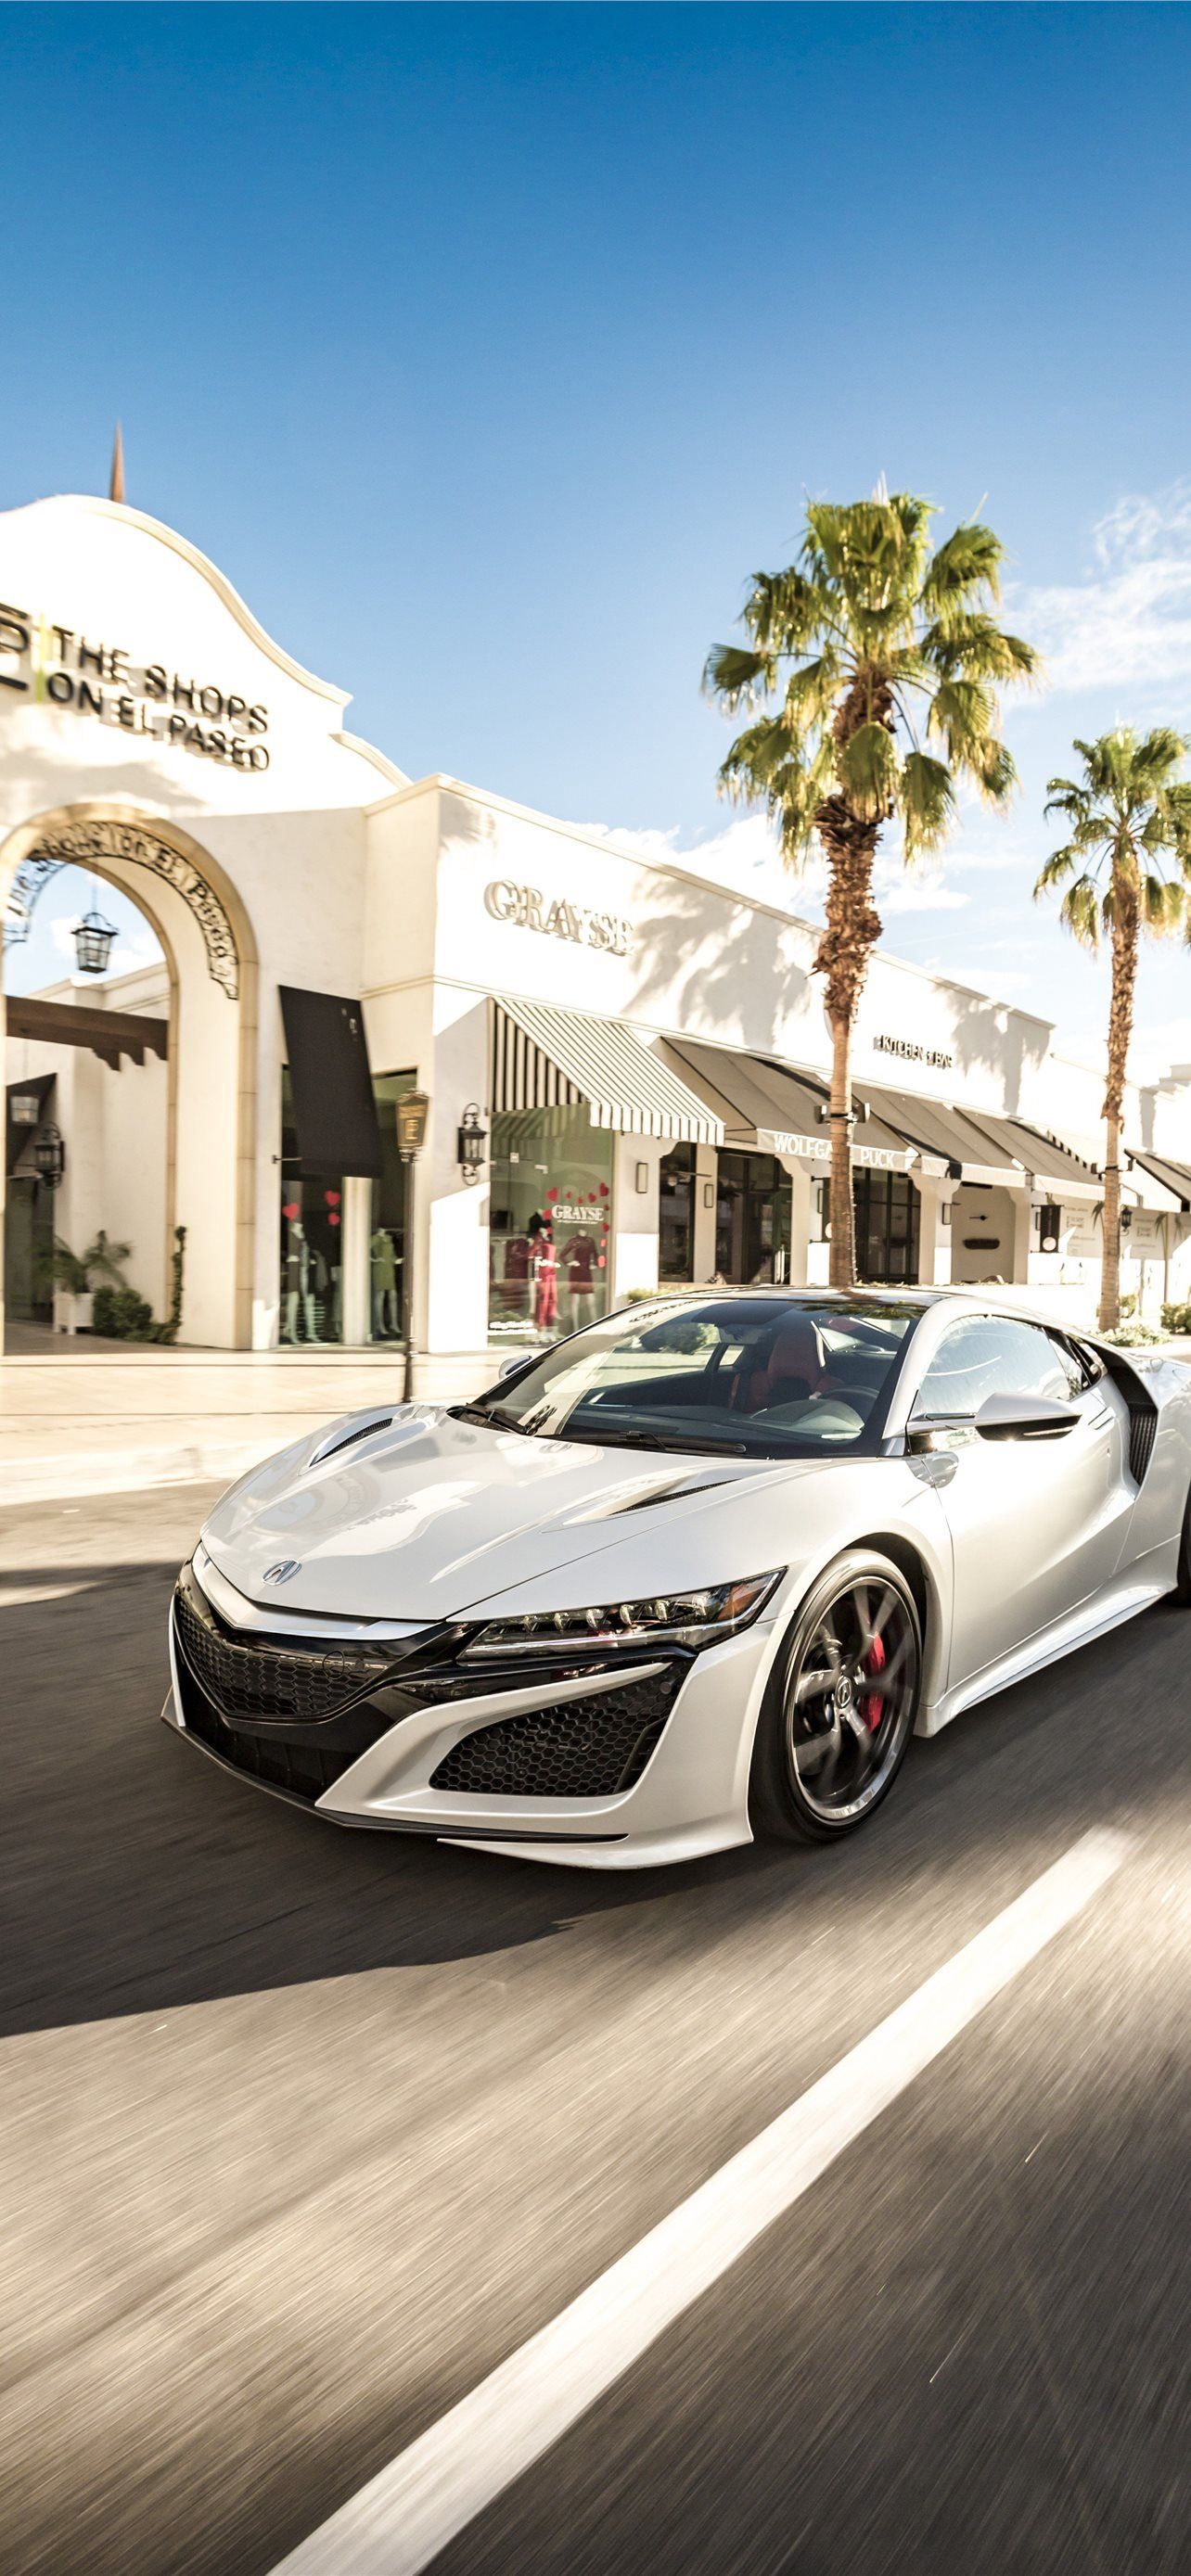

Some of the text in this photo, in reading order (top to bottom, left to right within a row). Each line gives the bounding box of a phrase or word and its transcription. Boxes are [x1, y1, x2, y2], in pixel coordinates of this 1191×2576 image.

[52, 625, 130, 683] THE
[145, 665, 269, 733] SHOPS
[47, 672, 270, 771] ON EL PASEO
[774, 1133, 895, 1167] WOLFGA PUCK
[551, 1205, 605, 1221] GRAYSE
